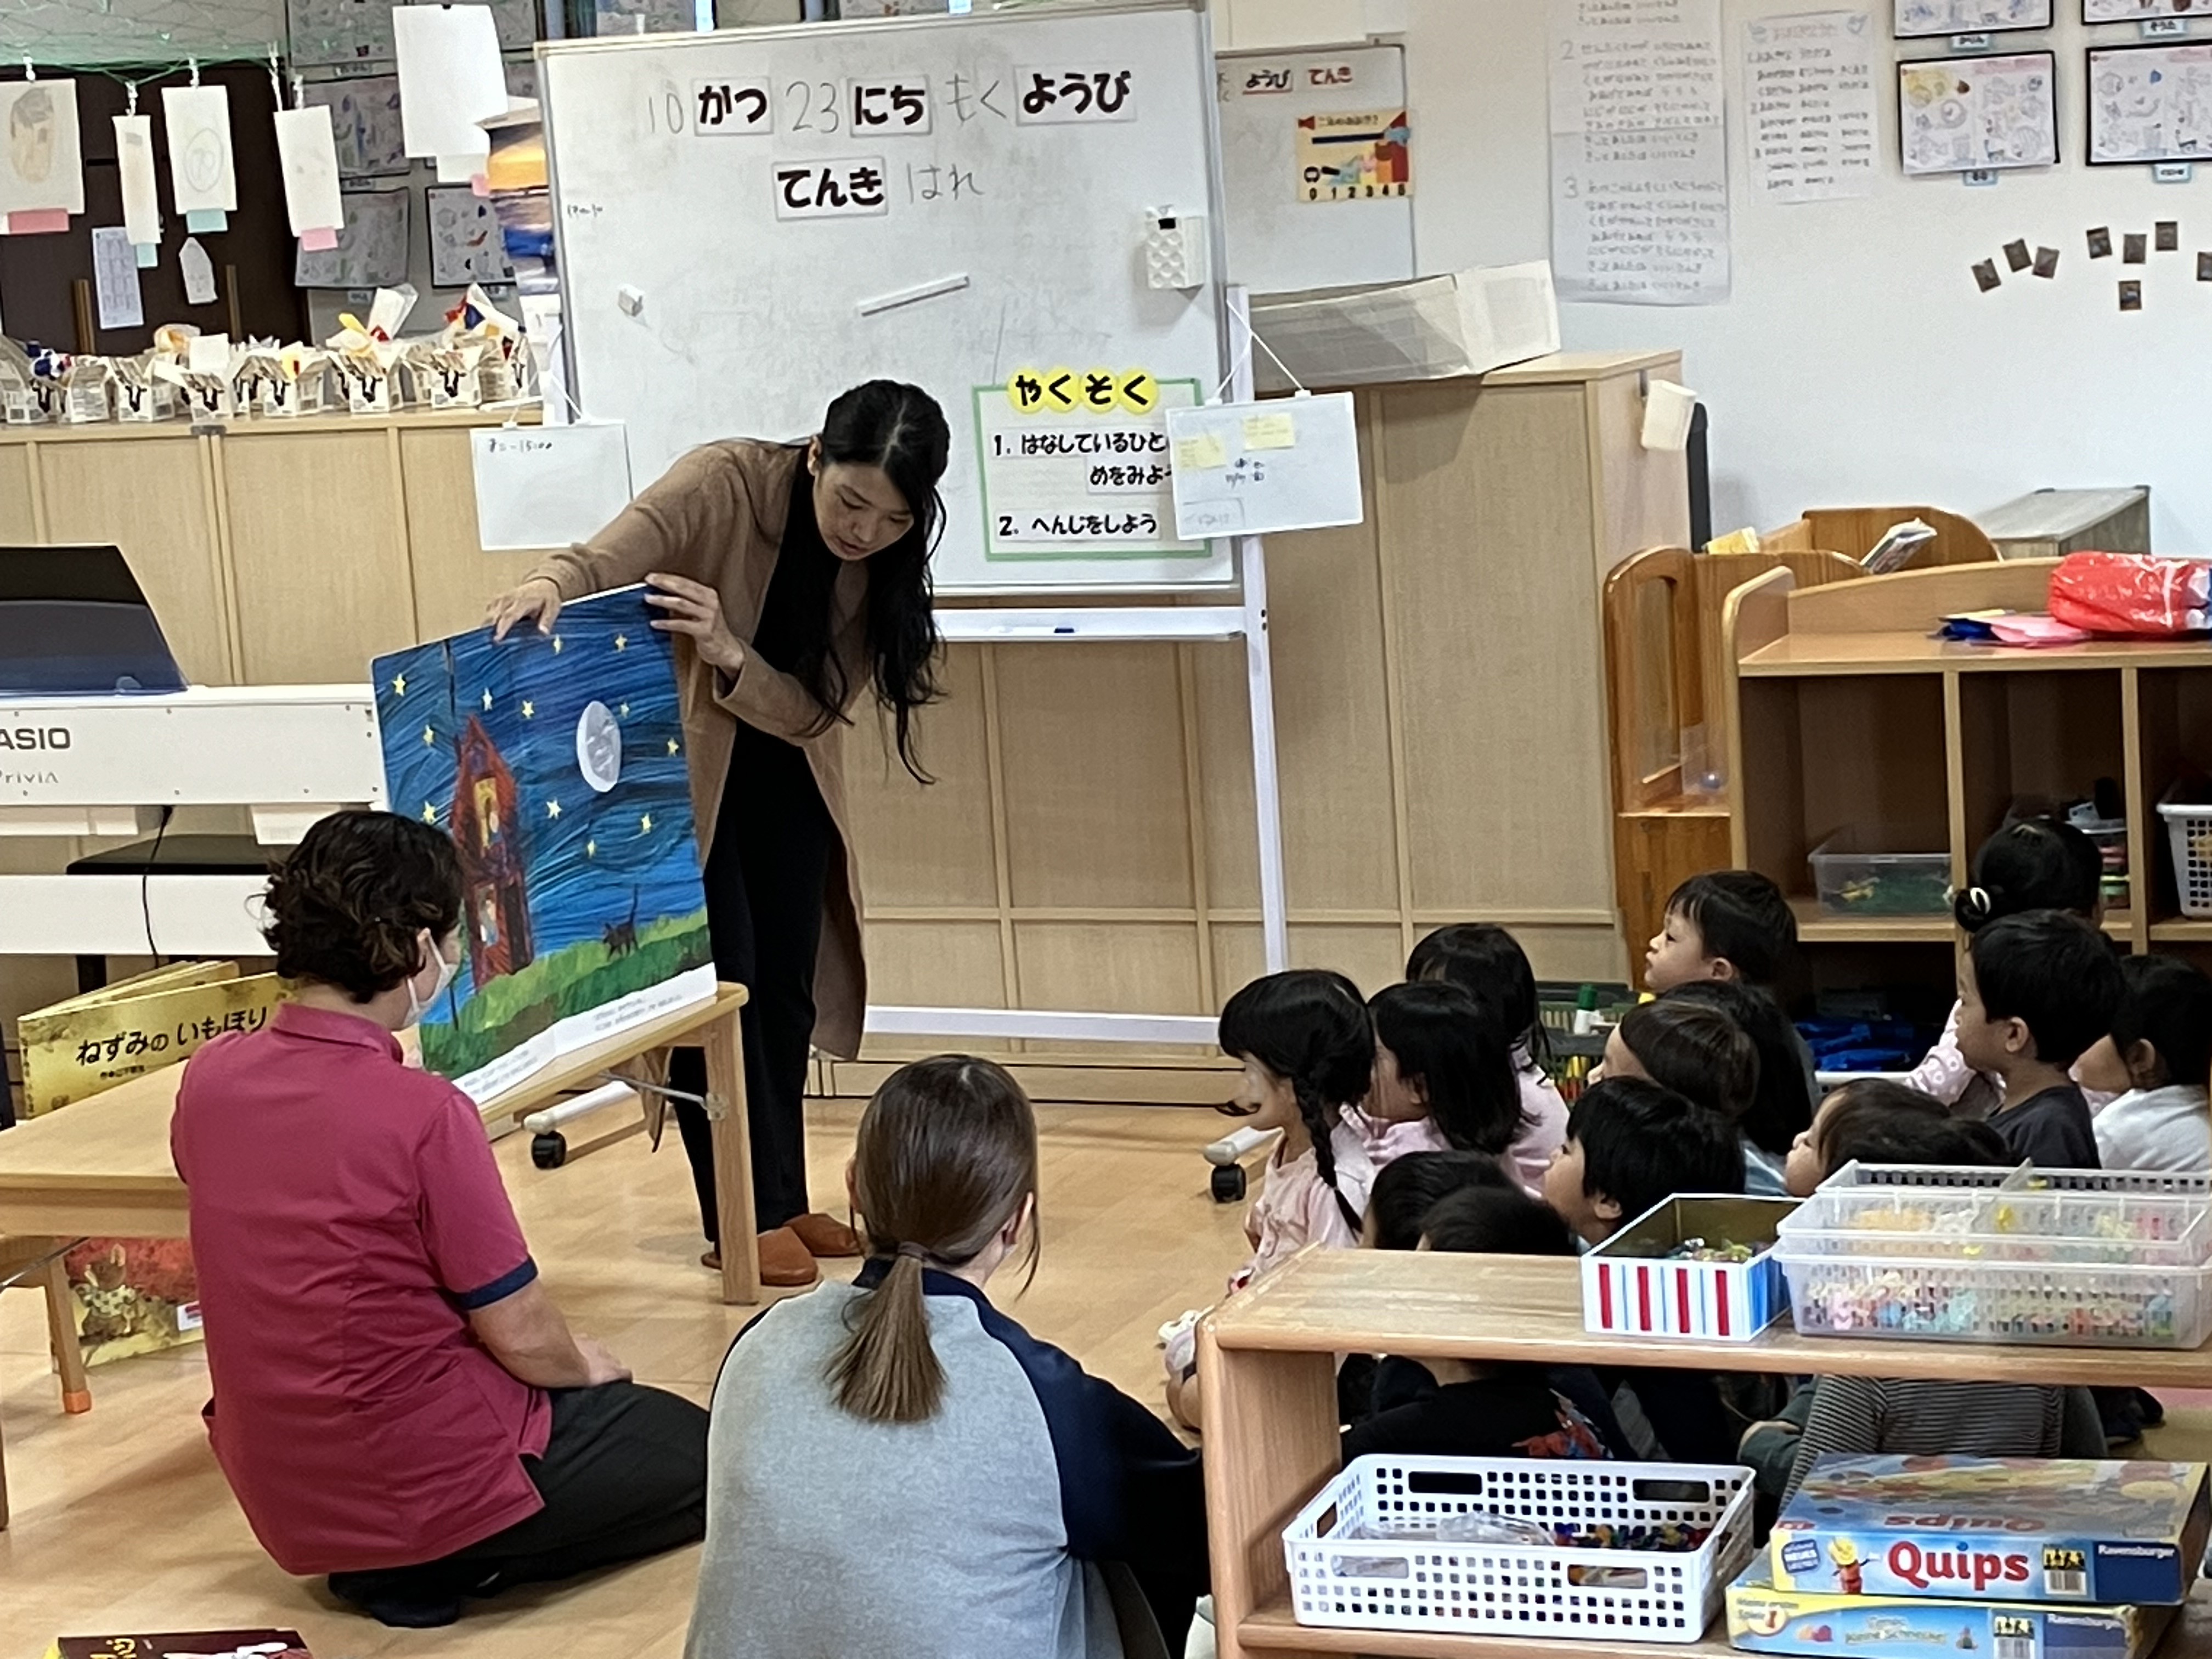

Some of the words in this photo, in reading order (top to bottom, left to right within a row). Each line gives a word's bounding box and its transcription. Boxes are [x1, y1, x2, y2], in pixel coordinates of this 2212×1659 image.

[1308, 66, 1352, 84] てんき
[649, 93, 684, 134] 10
[786, 81, 839, 133] 23
[855, 86, 925, 126] にち
[946, 74, 1007, 122] もく
[1023, 70, 1131, 114] ようび
[777, 167, 884, 208] てんき
[907, 163, 985, 204] はれ
[1015, 374, 1148, 406] やくそく
[994, 435, 1011, 456] 1.
[1022, 432, 1170, 455] はなしているひと
[999, 516, 1019, 536] 2.
[1031, 513, 1156, 534] へんじをしよう
[76, 1031, 169, 1065] ねずみの
[1888, 1541, 2029, 1591] Quips
